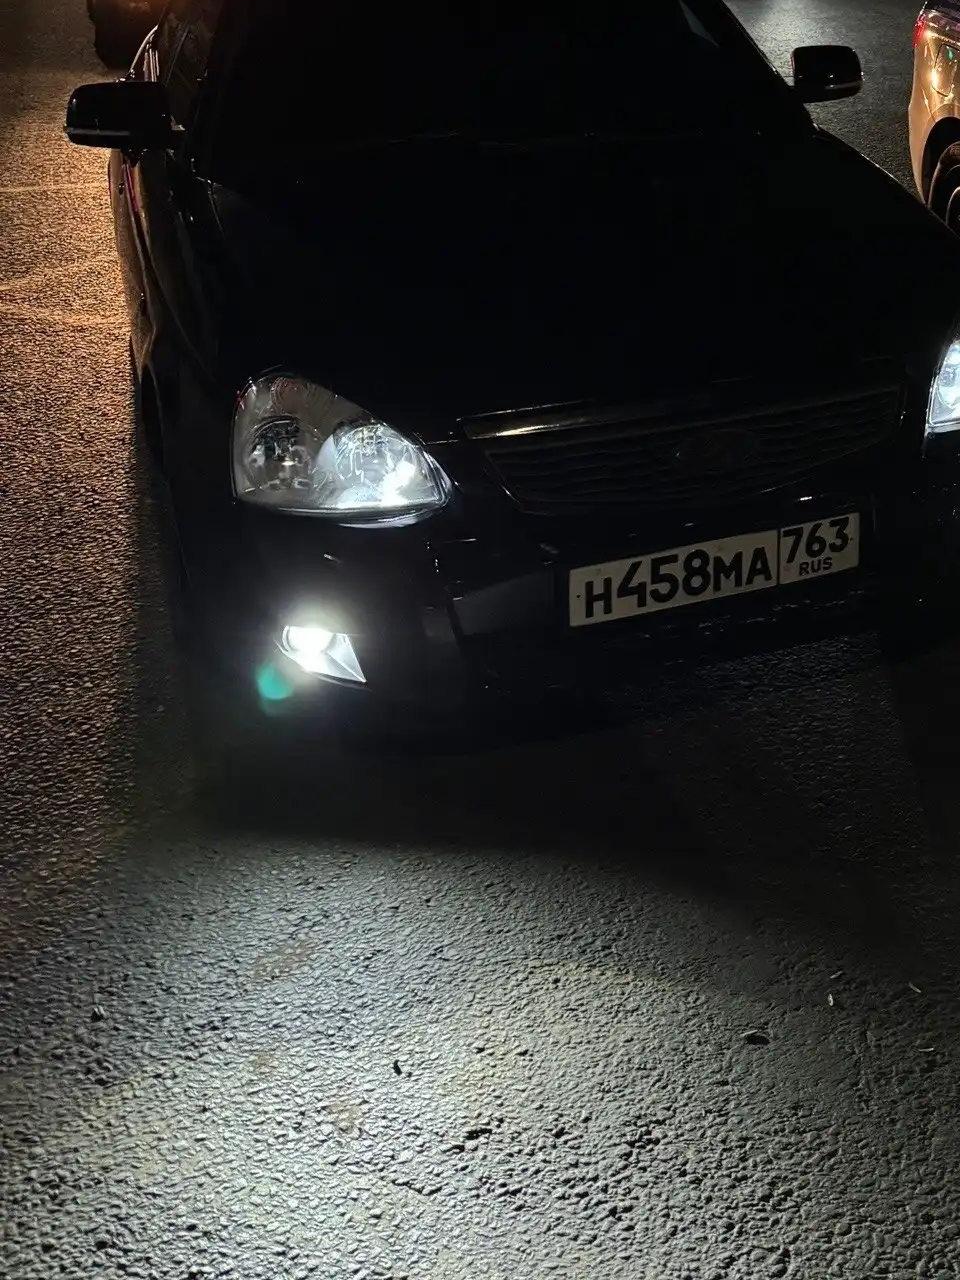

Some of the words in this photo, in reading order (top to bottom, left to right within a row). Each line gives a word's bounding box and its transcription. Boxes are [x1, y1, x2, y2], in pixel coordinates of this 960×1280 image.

[584, 546, 773, 618] Н458МА
[782, 516, 850, 564] 763
[799, 556, 834, 576] RUS
